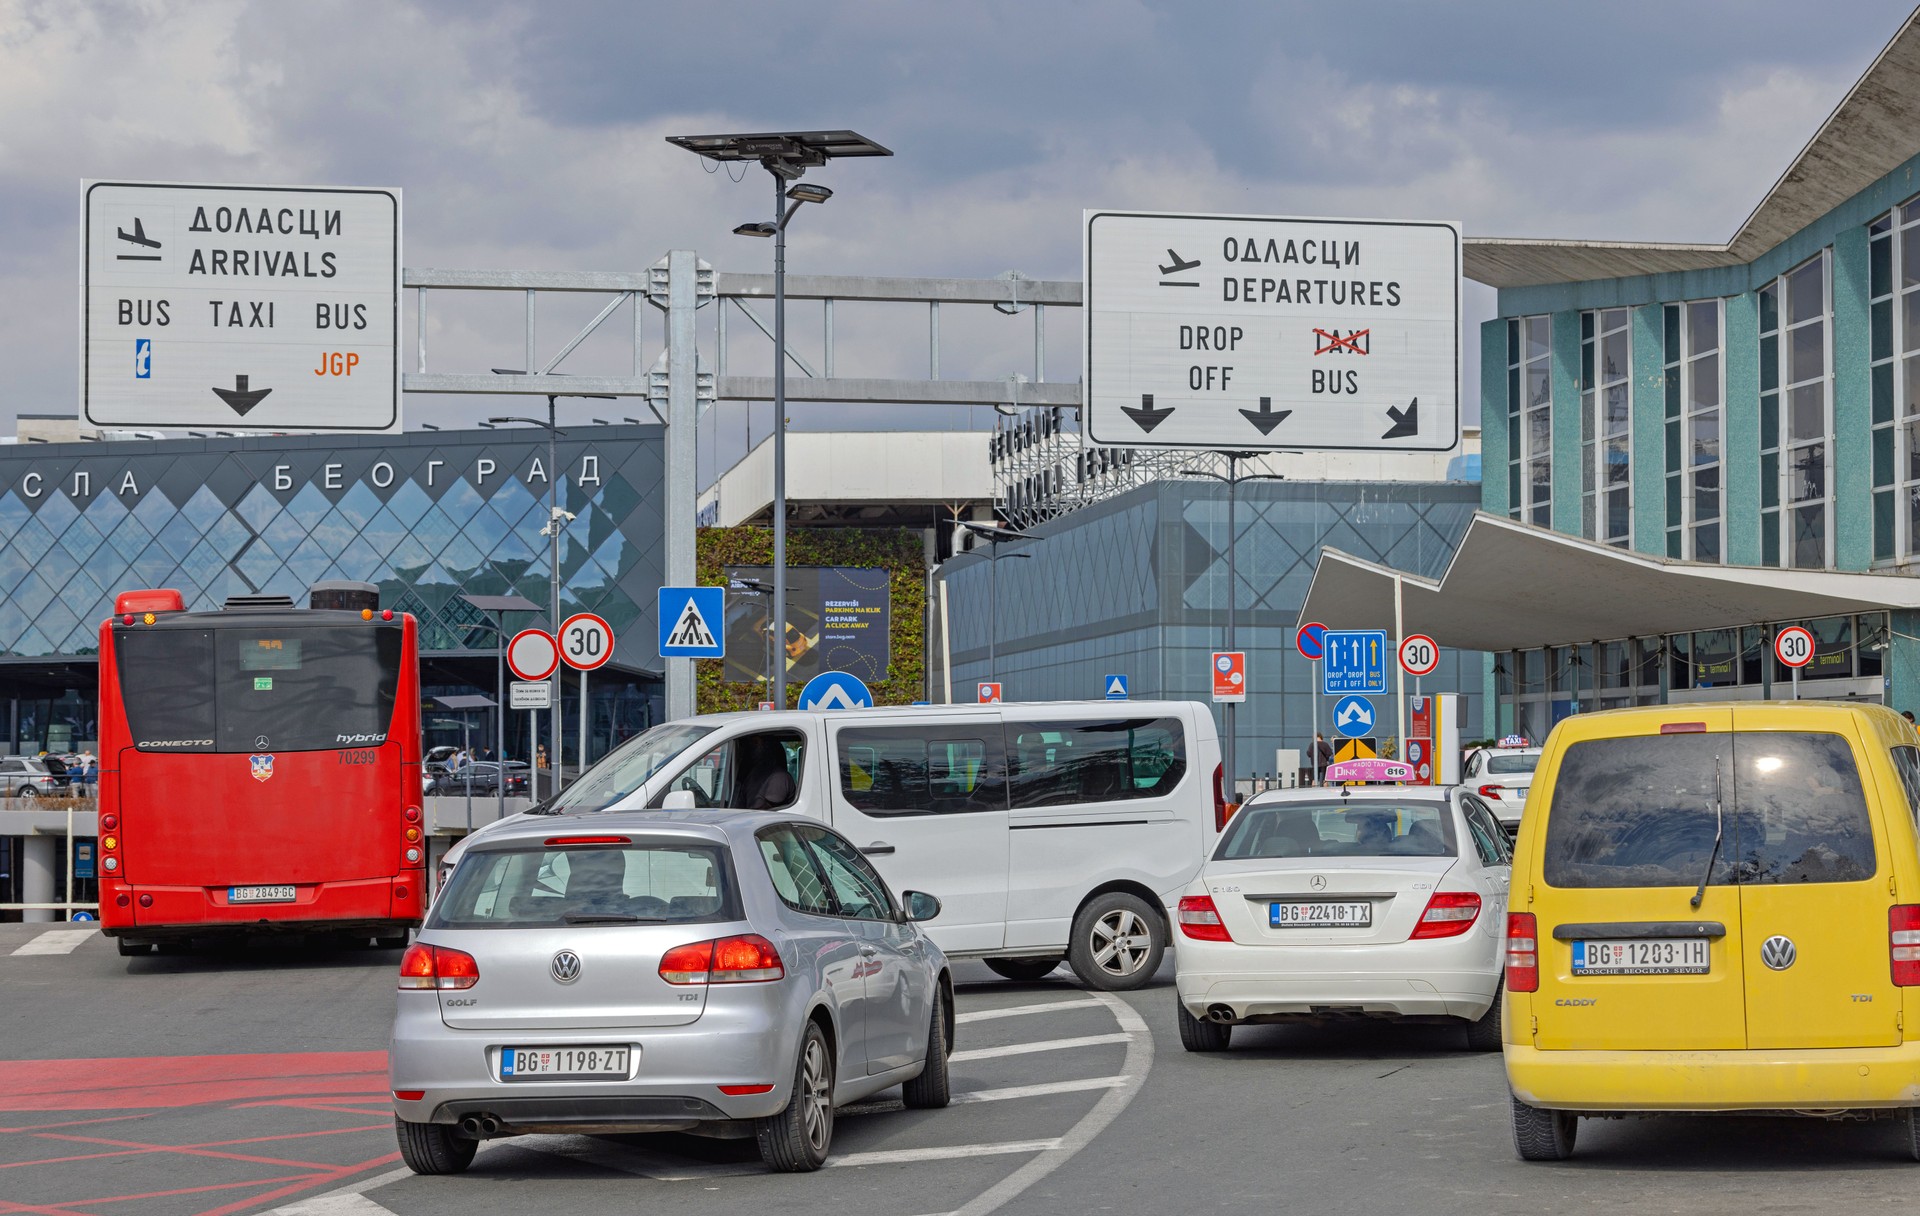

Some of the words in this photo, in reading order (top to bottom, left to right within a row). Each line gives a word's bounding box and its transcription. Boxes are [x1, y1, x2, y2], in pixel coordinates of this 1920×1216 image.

[189, 206, 341, 239] ДОЛАСЦИ
[189, 249, 337, 278] ARRIVALS
[1223, 236, 1360, 269] ОДЛАСЦИ
[1223, 277, 1401, 307] DEPARTURES
[118, 299, 170, 326] BUS
[209, 301, 274, 328] TAXI
[316, 303, 367, 330] BUS
[1180, 325, 1243, 351] DROP
[1314, 328, 1370, 355] TAXI
[314, 352, 359, 376] JGP
[1189, 365, 1234, 391] OFF
[1312, 369, 1358, 395] BUS
[275, 455, 600, 491] БЕОГРАД
[570, 628, 600, 656] 30
[1784, 637, 1806, 657] 30
[1408, 645, 1430, 666] 30
[138, 739, 214, 747] CONECTO
[336, 734, 386, 744] hybrid
[338, 750, 375, 765] 70299
[236, 888, 248, 898] BG
[1281, 906, 1299, 921] BG
[1588, 944, 1610, 965] BG
[1555, 998, 1597, 1007] CADDY
[1851, 994, 1873, 1003] TDI
[517, 1052, 538, 1072] BG
